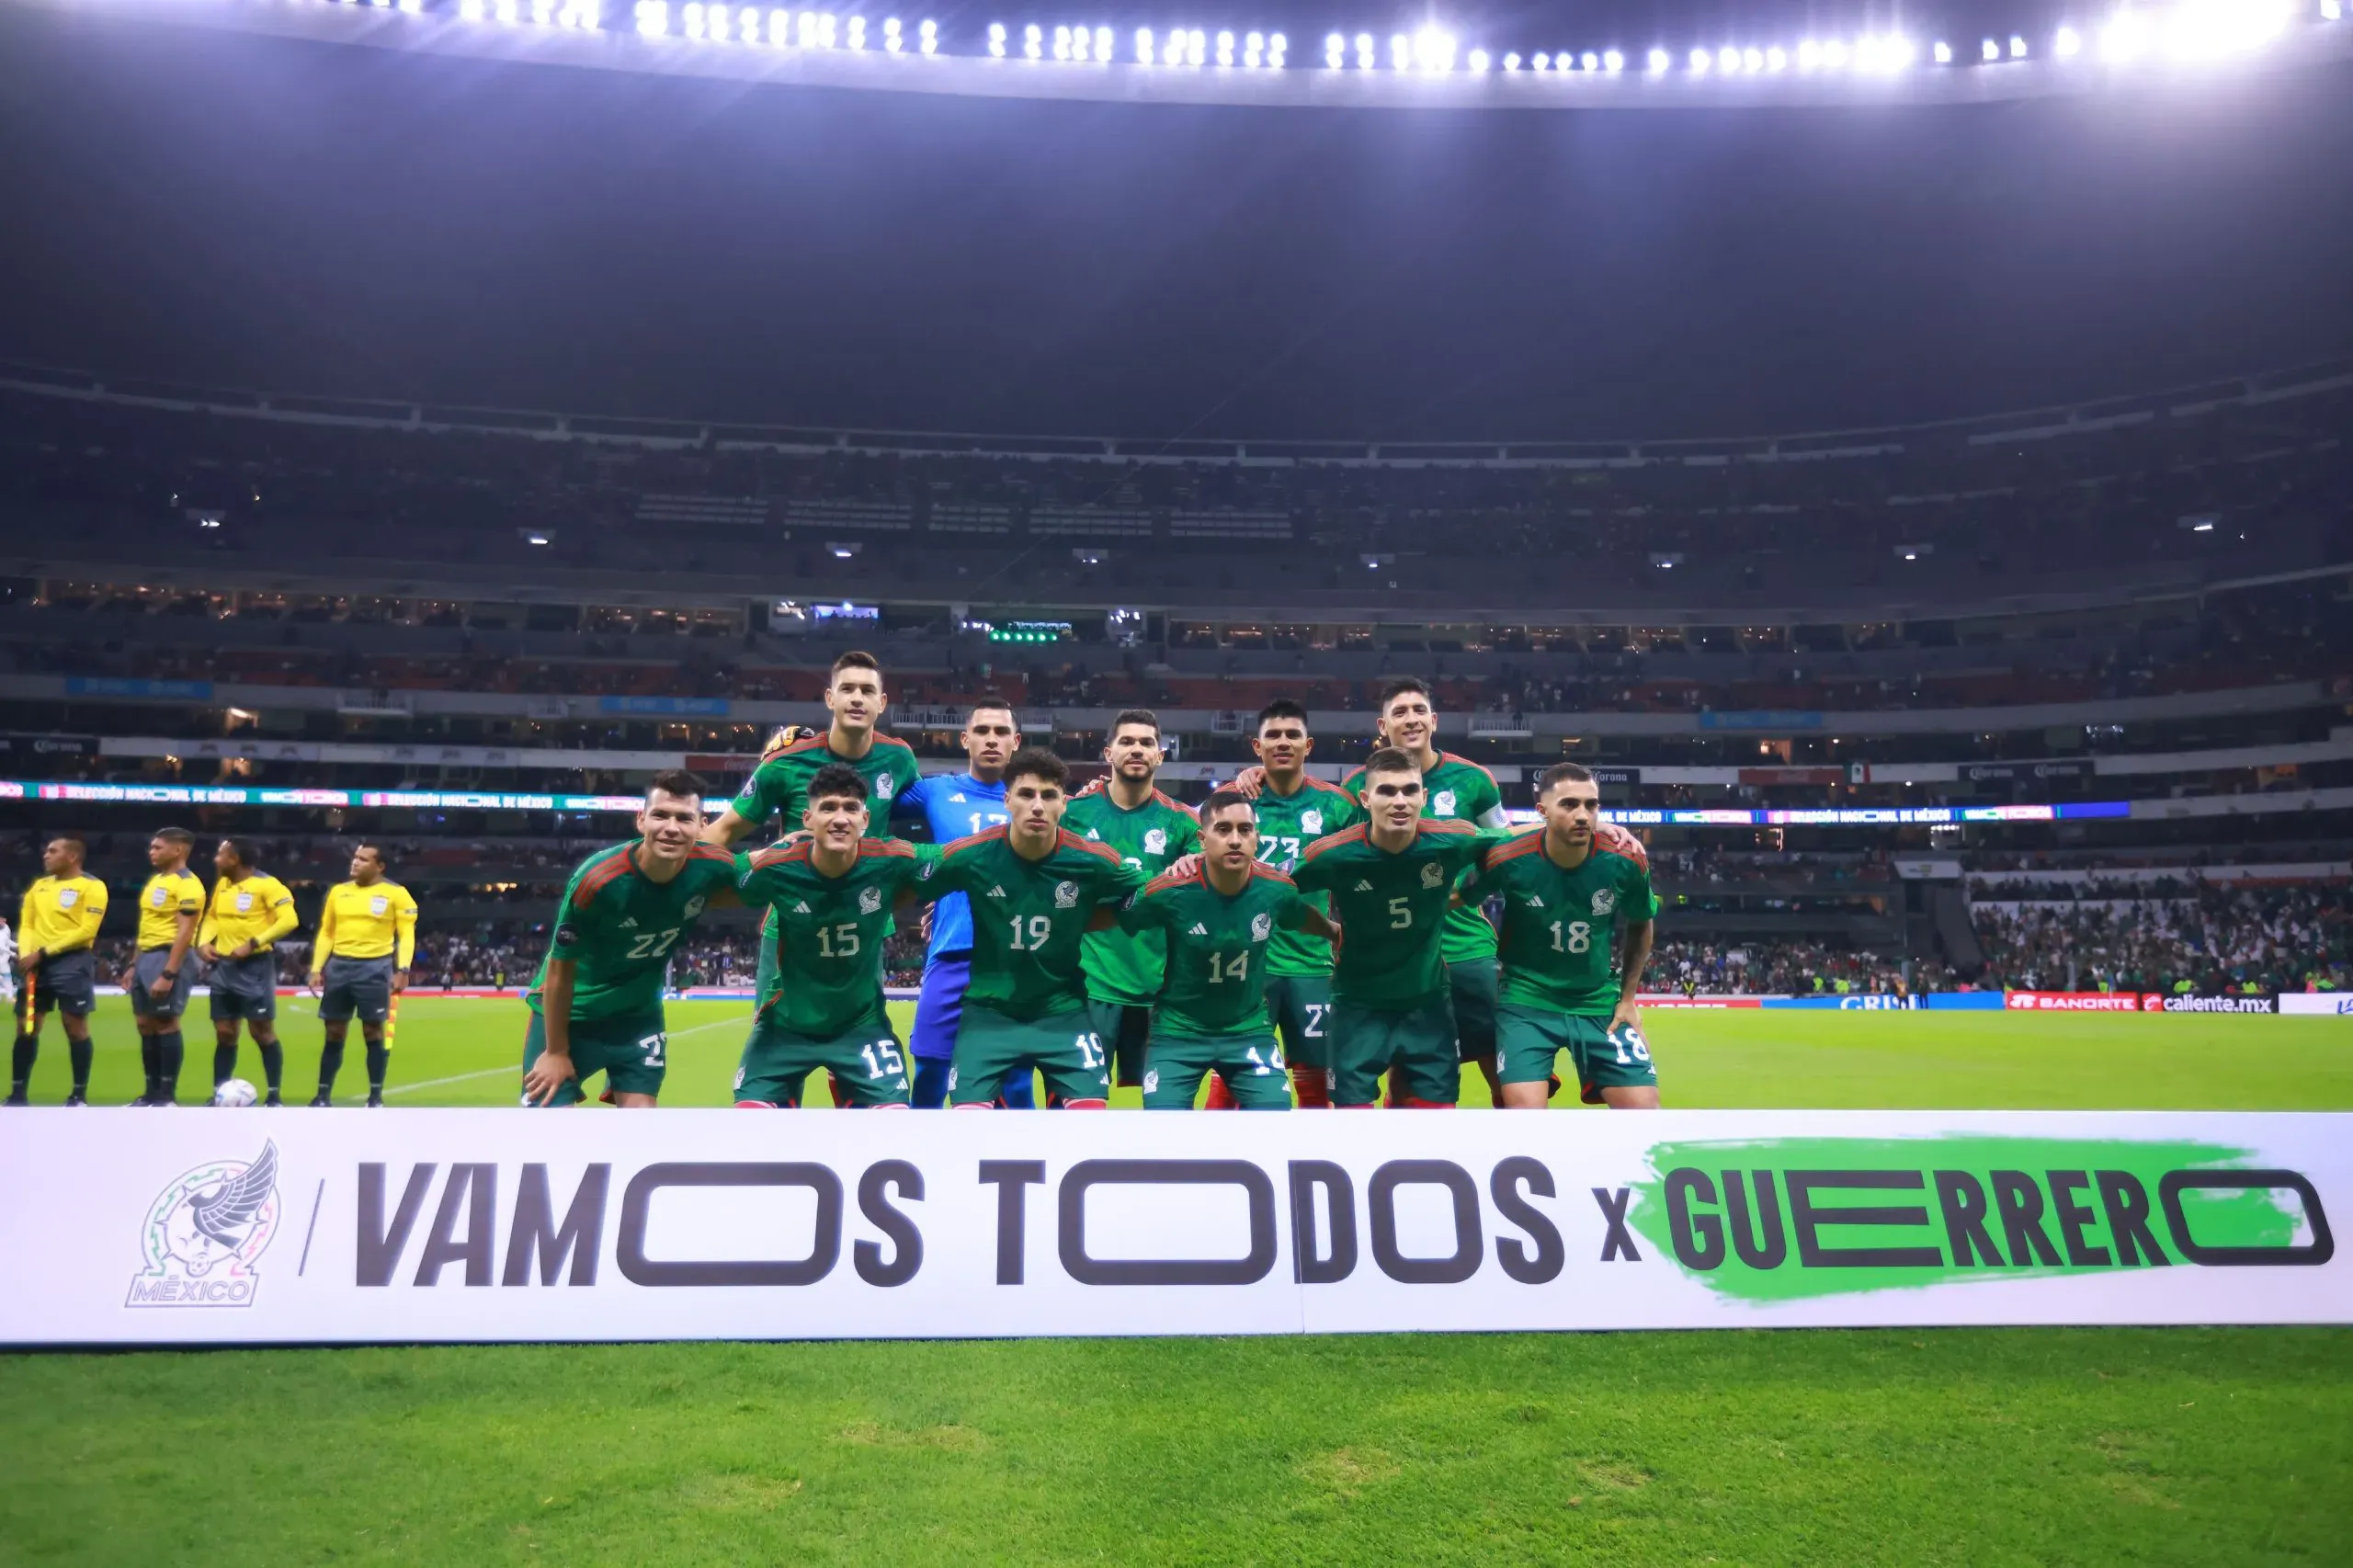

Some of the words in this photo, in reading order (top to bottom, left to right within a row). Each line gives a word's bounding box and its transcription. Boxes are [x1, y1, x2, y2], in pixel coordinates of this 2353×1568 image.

[1388, 897, 1412, 928] 5
[626, 927, 680, 959] 22
[816, 923, 860, 958] 15
[1009, 915, 1051, 950] 19
[1550, 921, 1590, 954] 18
[1209, 949, 1248, 983] 14
[2040, 997, 2135, 1010] BANORTE
[2163, 995, 2271, 1013] caliente.mx
[1305, 1004, 1331, 1037] 2
[861, 1040, 904, 1080] 15
[1608, 1028, 1649, 1063] 18
[357, 1159, 926, 1287] VAMOS
[979, 1155, 1565, 1285] TODOS
[1664, 1166, 2335, 1270] GUERRERO
[133, 1275, 250, 1301] MÉXICO
